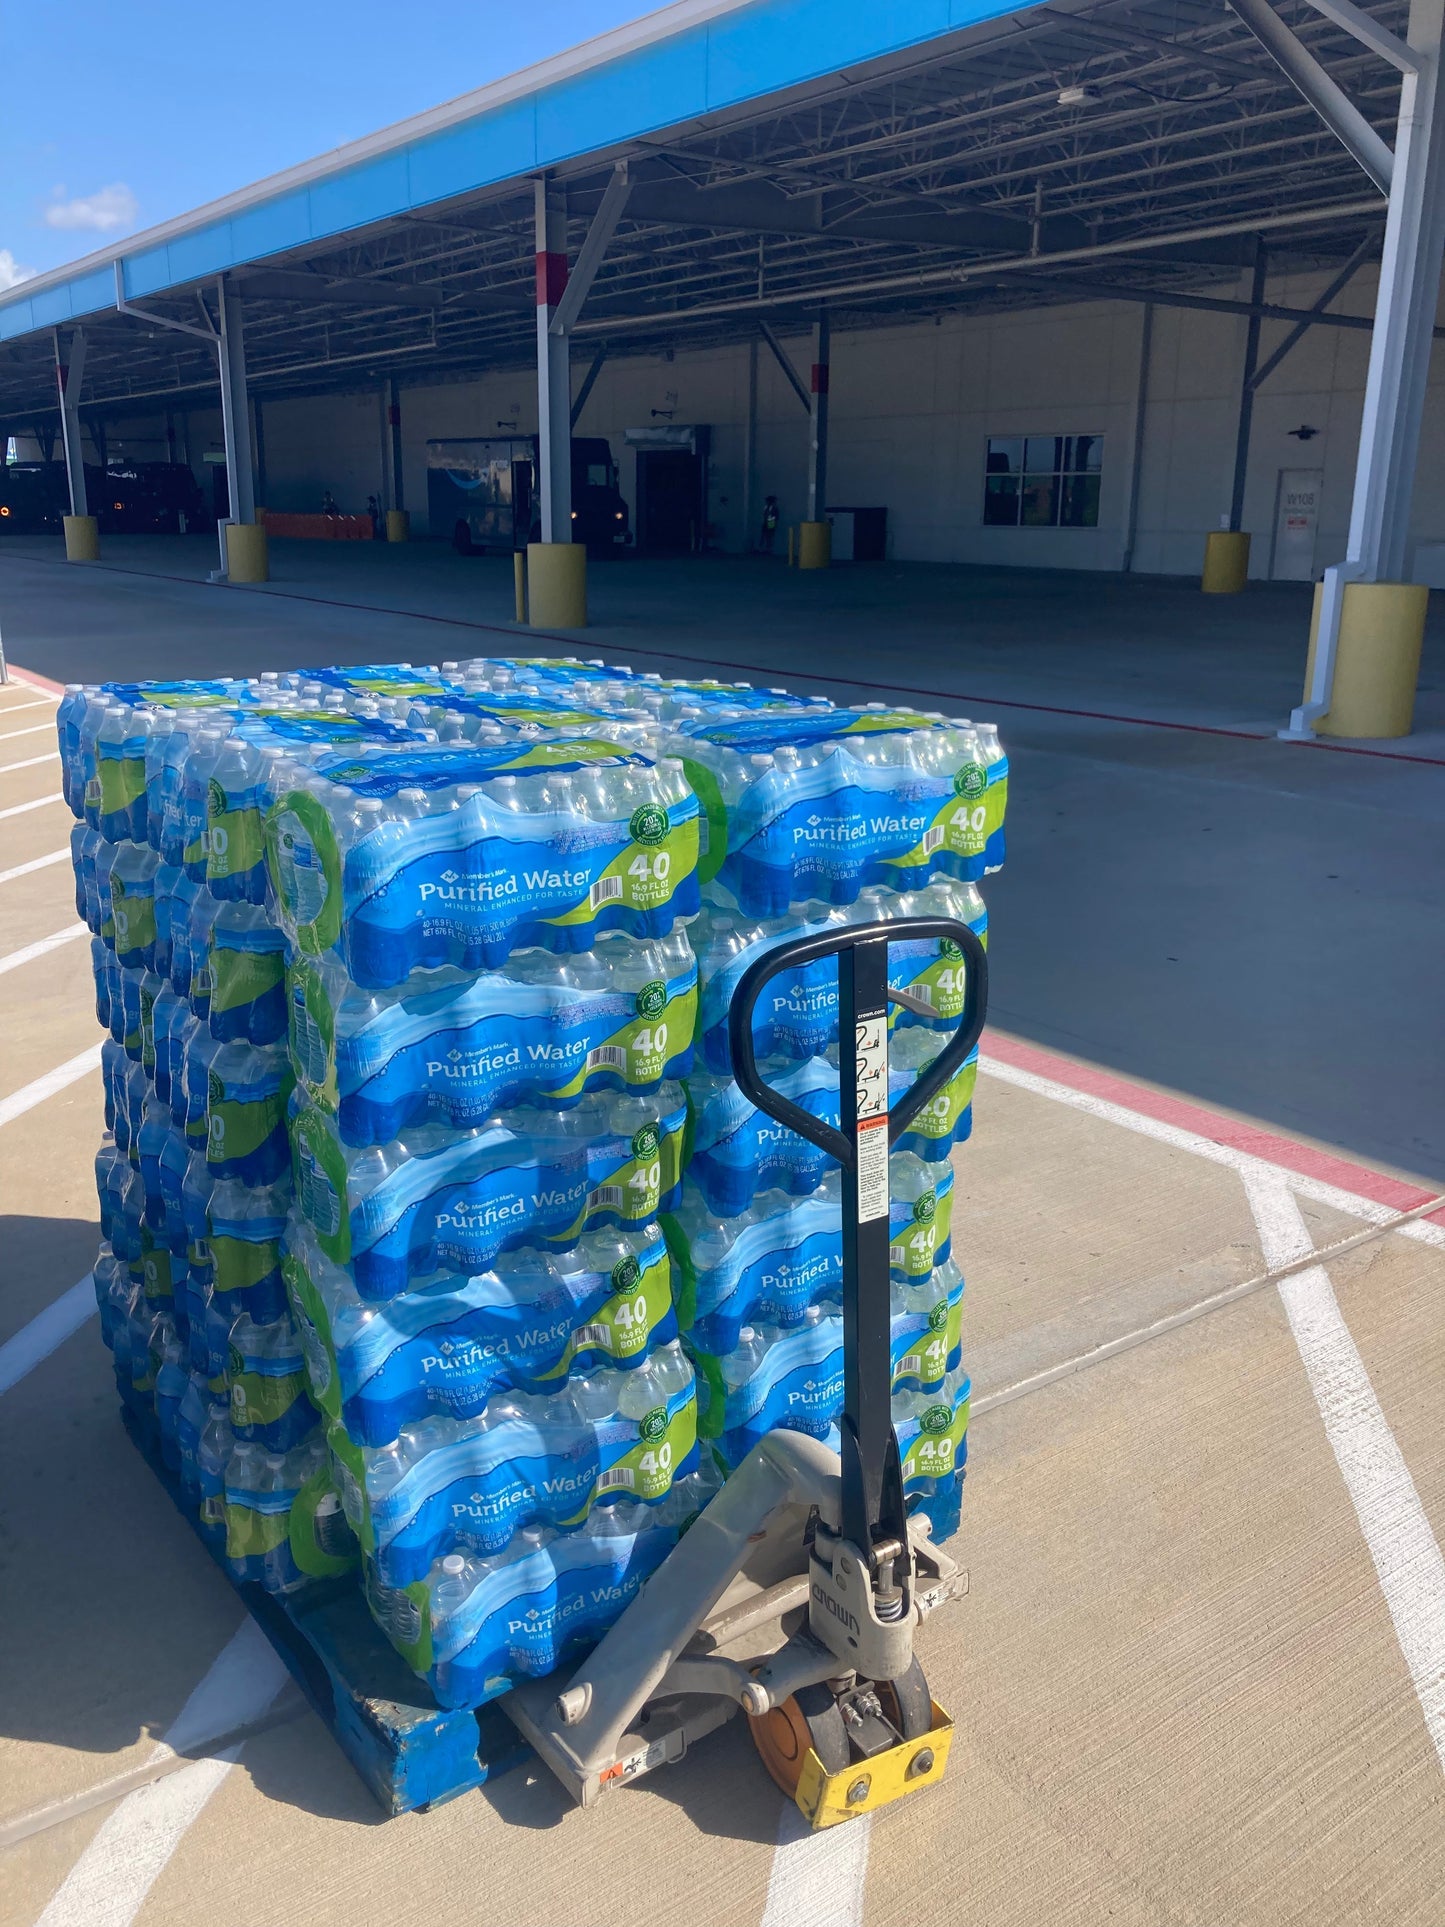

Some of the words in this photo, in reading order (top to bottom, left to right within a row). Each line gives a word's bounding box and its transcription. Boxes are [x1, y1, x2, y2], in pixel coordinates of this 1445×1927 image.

[793, 820, 867, 844] Purified
[870, 816, 926, 834] Water
[950, 806, 986, 832] 40
[809, 843, 845, 851] MINERAL
[847, 838, 876, 850] ENHANCED
[951, 838, 984, 850] BOTTLES
[952, 831, 966, 840] 16.9
[967, 832, 976, 840] FL
[976, 832, 984, 840] OZ
[628, 852, 671, 881] 40
[419, 875, 518, 901] Purified
[523, 868, 592, 889] Water
[631, 883, 647, 893] 16.9
[649, 883, 659, 891] FL
[660, 880, 669, 889] OZ
[631, 889, 670, 902] BOTTLES
[444, 902, 488, 912] MINERAL
[491, 893, 532, 909] ENHANCED
[535, 890, 553, 899] FOR
[557, 888, 584, 898] TASTE
[937, 966, 966, 994] 40
[857, 1009, 886, 1019] crown.com
[465, 1044, 493, 1057] Member's
[632, 1023, 668, 1056] 40
[426, 1048, 520, 1077] Purified
[527, 1036, 591, 1061] Water
[635, 1058, 650, 1067] 16.9
[652, 1056, 660, 1065] FL
[451, 1078, 487, 1087] MINERAL
[490, 1063, 535, 1079] ENHANCED
[559, 1058, 581, 1069] TASTE
[911, 1121, 948, 1133] BOTTLES
[628, 1161, 660, 1193] 40
[435, 1198, 526, 1229] Purified
[531, 1180, 588, 1208] Water
[471, 1197, 499, 1210] Member's
[499, 1193, 515, 1201] Mark
[458, 1229, 494, 1237] MINERAL
[496, 1212, 540, 1230] ENHANCED
[910, 1225, 936, 1253] 40
[761, 1258, 829, 1288] Purified
[614, 1295, 647, 1330] 40
[420, 1338, 511, 1374] Purified
[515, 1316, 574, 1349] Water
[619, 1331, 634, 1340] 16.9
[445, 1366, 480, 1379] MINERAL
[639, 1442, 672, 1476] 40
[919, 1438, 952, 1459] 40
[921, 1463, 951, 1472] BOTTLES
[452, 1484, 537, 1517] Purified
[542, 1463, 599, 1494] Water
[475, 1513, 507, 1525] MINERAL
[508, 1595, 585, 1634] Purified
[591, 1570, 642, 1603] Water
